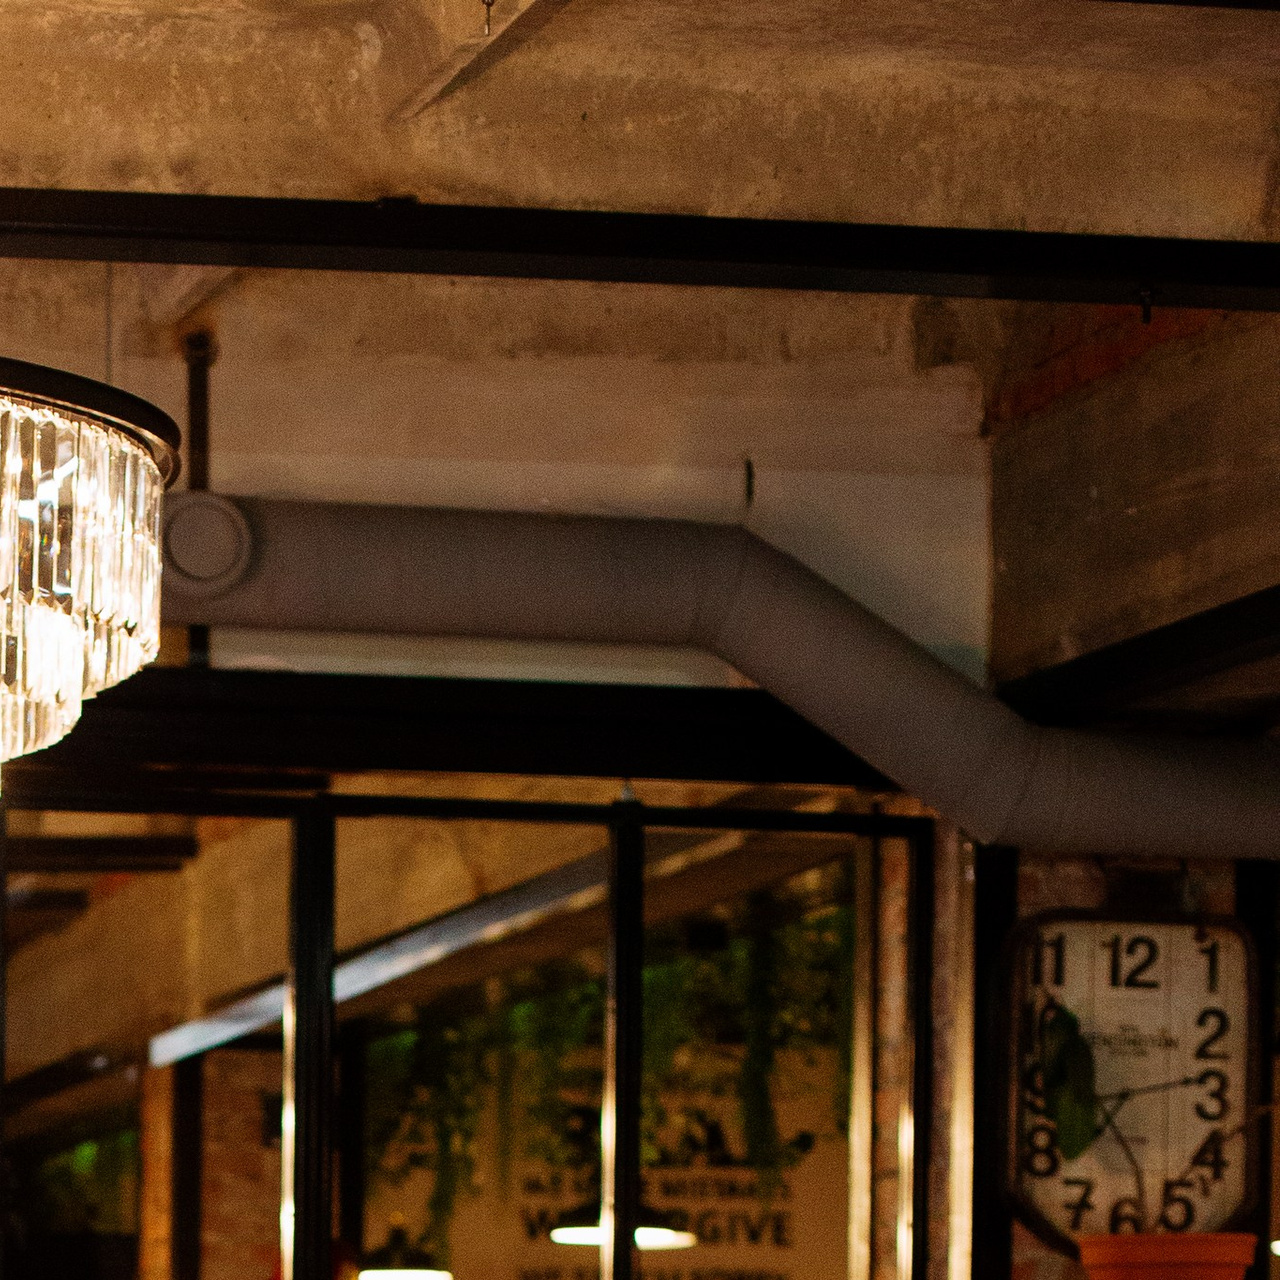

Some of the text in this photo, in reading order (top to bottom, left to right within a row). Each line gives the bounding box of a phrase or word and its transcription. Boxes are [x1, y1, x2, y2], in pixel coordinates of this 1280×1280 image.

[1101, 935, 1160, 989] 12
[1199, 942, 1219, 994] 1
[1195, 1007, 1230, 1061] 2
[1195, 1069, 1229, 1121] 3
[1025, 1125, 1059, 1178] 8
[1191, 1130, 1229, 1181] 4
[1063, 1176, 1094, 1231] 7
[1161, 1178, 1194, 1232] 5
